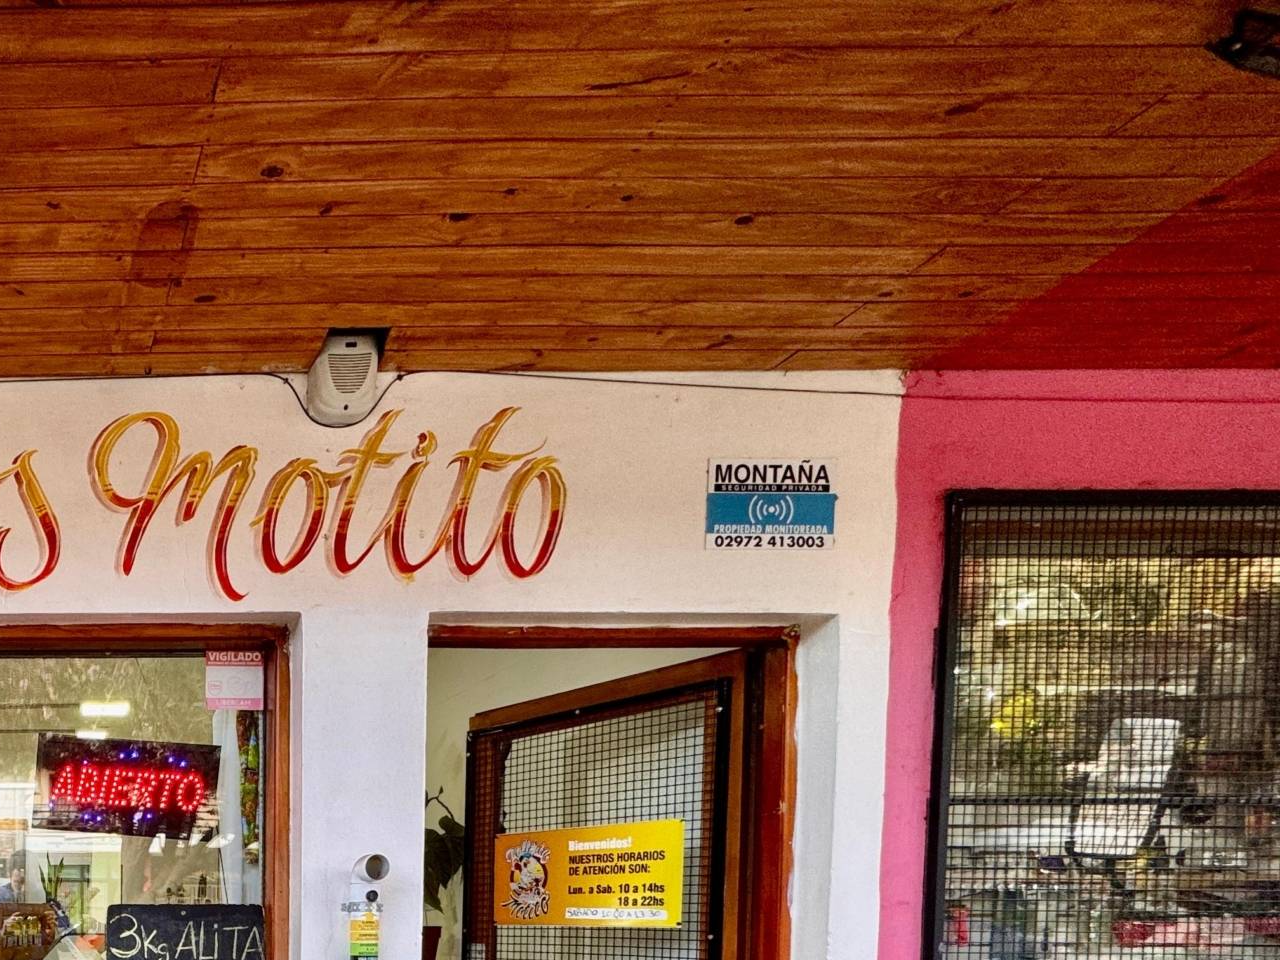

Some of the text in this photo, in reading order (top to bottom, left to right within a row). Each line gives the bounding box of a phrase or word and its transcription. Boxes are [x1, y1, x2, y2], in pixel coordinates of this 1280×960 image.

[715, 460, 829, 483] MONTAÑA
[89, 407, 569, 601] Motito
[714, 524, 828, 534] PROPIEDAD MONITOREADA
[715, 536, 824, 547] 02972 413003
[568, 837, 632, 851] Bienvenidos!
[569, 850, 665, 865] NUESTROS HORARIOS
[569, 863, 650, 876] DE ATENCIÓN SON:
[568, 885, 585, 895] Lun.
[596, 884, 615, 894] Sab.
[619, 884, 630, 893] 10
[642, 883, 664, 893] 14hs
[618, 897, 628, 906] 18
[640, 896, 664, 906] 22hs
